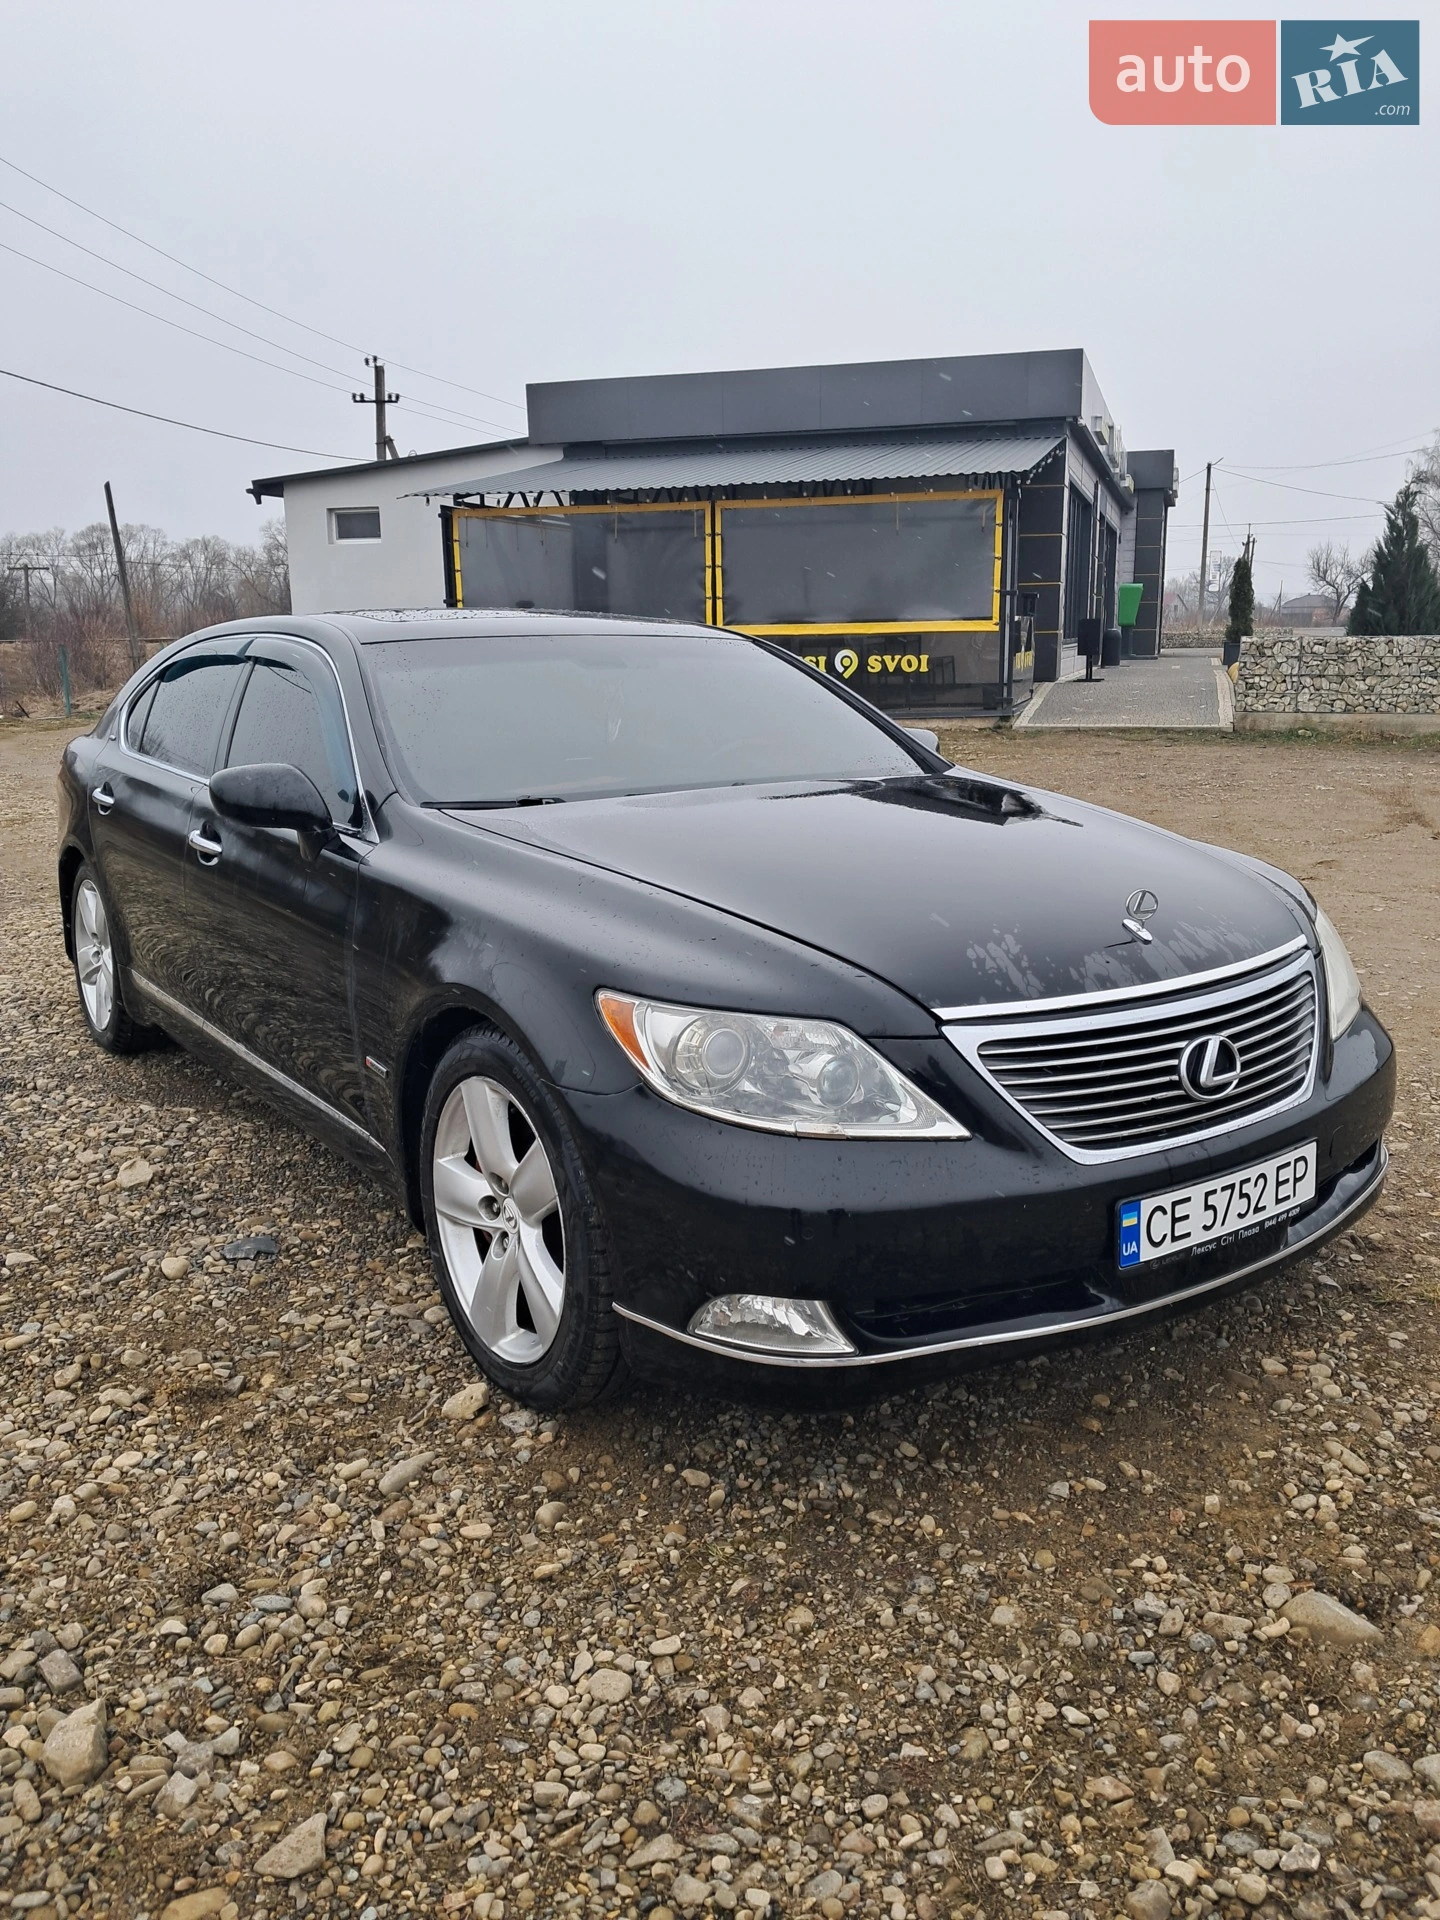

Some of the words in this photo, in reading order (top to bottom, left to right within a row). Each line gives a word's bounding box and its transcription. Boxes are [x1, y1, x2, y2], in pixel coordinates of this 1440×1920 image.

[798, 655, 827, 673] SI
[867, 654, 929, 673] SVOI
[1146, 1196, 1192, 1248] CE
[1202, 1173, 1268, 1232] 5752
[1275, 1155, 1309, 1206] EP
[1122, 1241, 1138, 1256] UA
[1191, 1242, 1217, 1256] Лексус
[1238, 1226, 1260, 1240] Плаза
